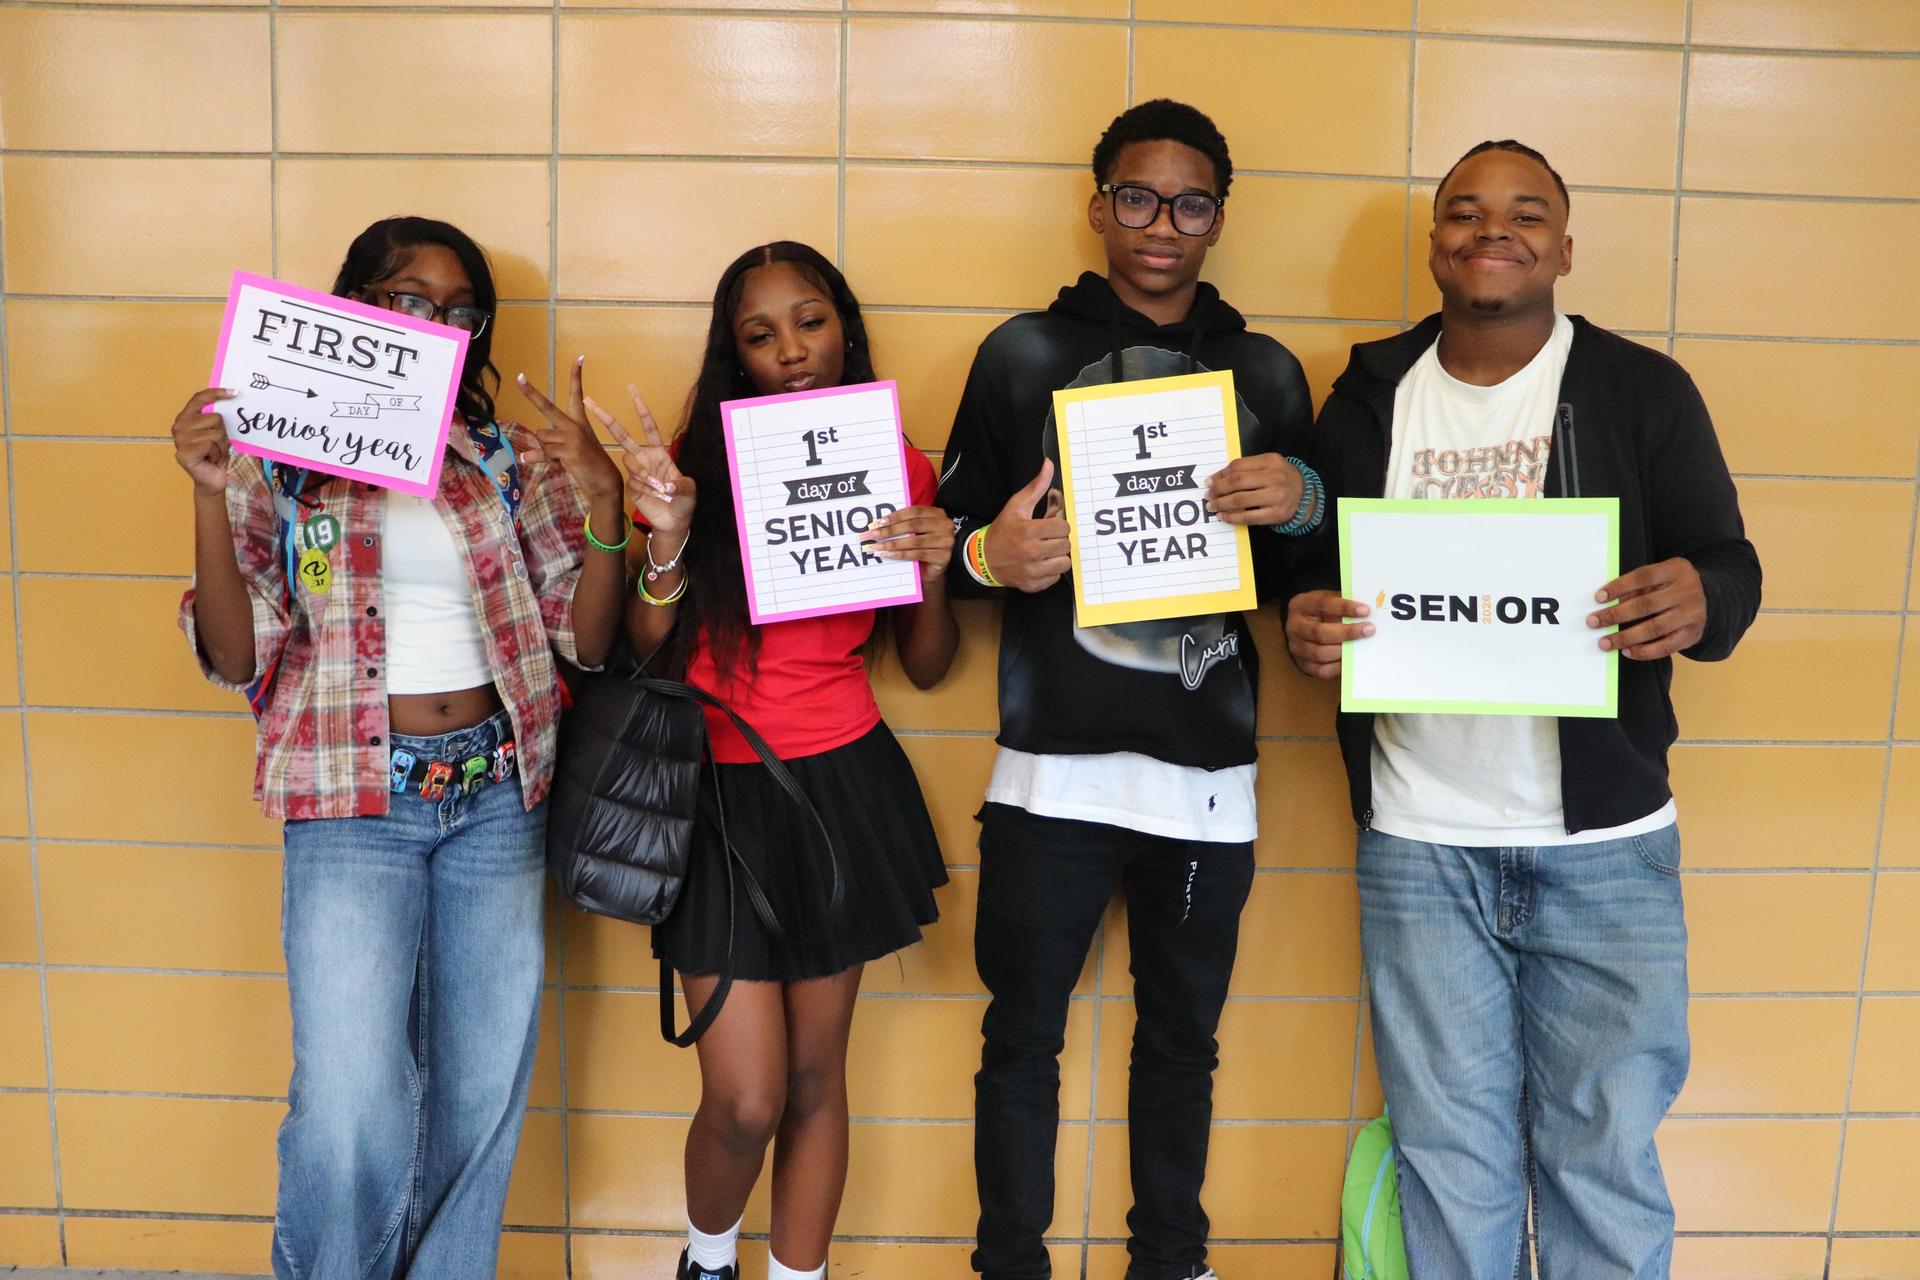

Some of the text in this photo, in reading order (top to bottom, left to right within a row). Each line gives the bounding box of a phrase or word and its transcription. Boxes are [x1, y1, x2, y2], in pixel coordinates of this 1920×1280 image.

[252, 308, 419, 380] FIRST
[348, 397, 404, 416] DAY OF
[237, 407, 422, 471] senior year
[801, 427, 839, 467] 1st
[1132, 421, 1168, 460] 1st
[797, 477, 857, 500] day of
[1127, 470, 1185, 492] day of
[307, 519, 334, 549] 19
[1117, 532, 1208, 566] YEAR
